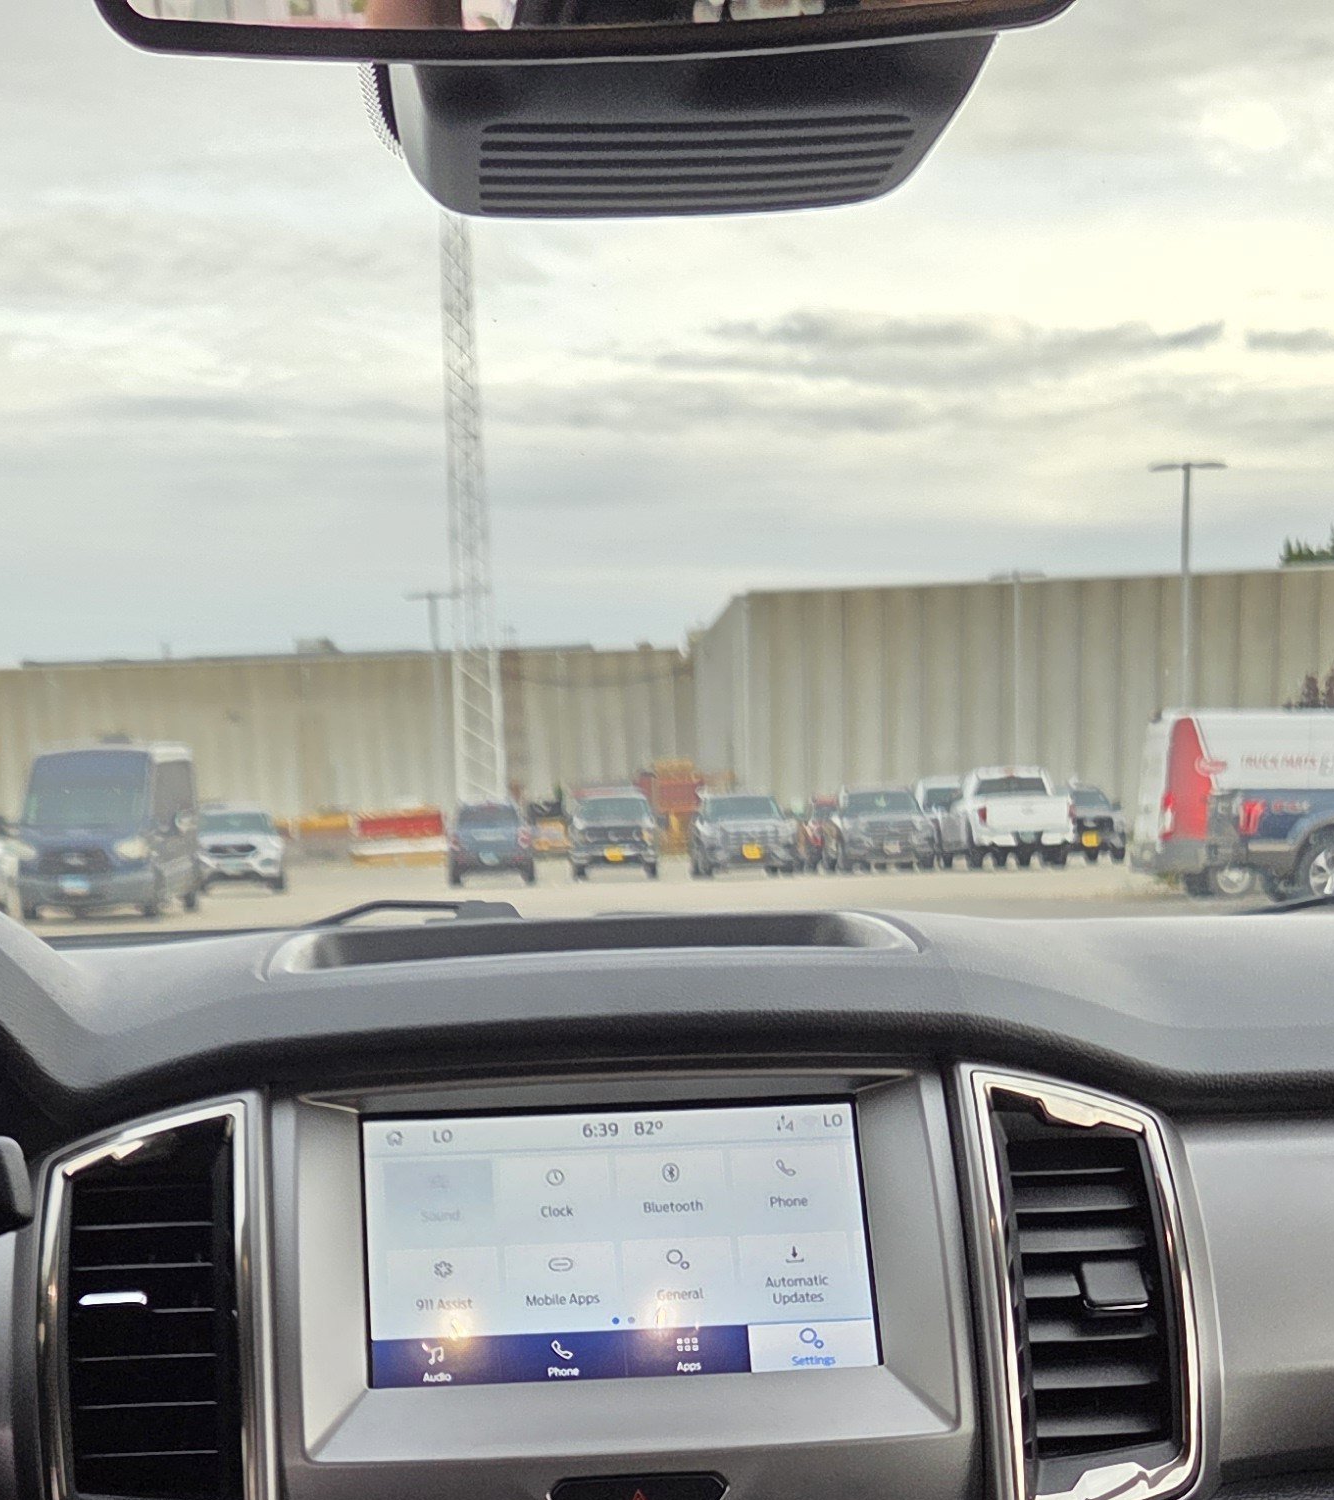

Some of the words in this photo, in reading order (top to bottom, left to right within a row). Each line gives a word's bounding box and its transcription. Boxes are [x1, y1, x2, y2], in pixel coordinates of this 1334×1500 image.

[822, 1113, 844, 1128] LO
[432, 1128, 453, 1144] LO
[582, 1122, 619, 1139] 6:39
[643, 1199, 704, 1214] Bluetooth
[769, 1195, 808, 1210] Phone
[420, 1208, 461, 1223] Sound
[540, 1204, 574, 1219] Clock
[764, 1274, 829, 1289] Automatic
[525, 1294, 565, 1308] Mobile
[567, 1292, 600, 1310] Apps
[656, 1287, 704, 1303] General
[772, 1290, 824, 1308] Updates
[436, 1296, 474, 1311] Assist
[676, 1359, 702, 1375] Apps
[790, 1352, 836, 1370] Settings
[422, 1370, 452, 1384] Audio
[547, 1364, 580, 1378] Phone
